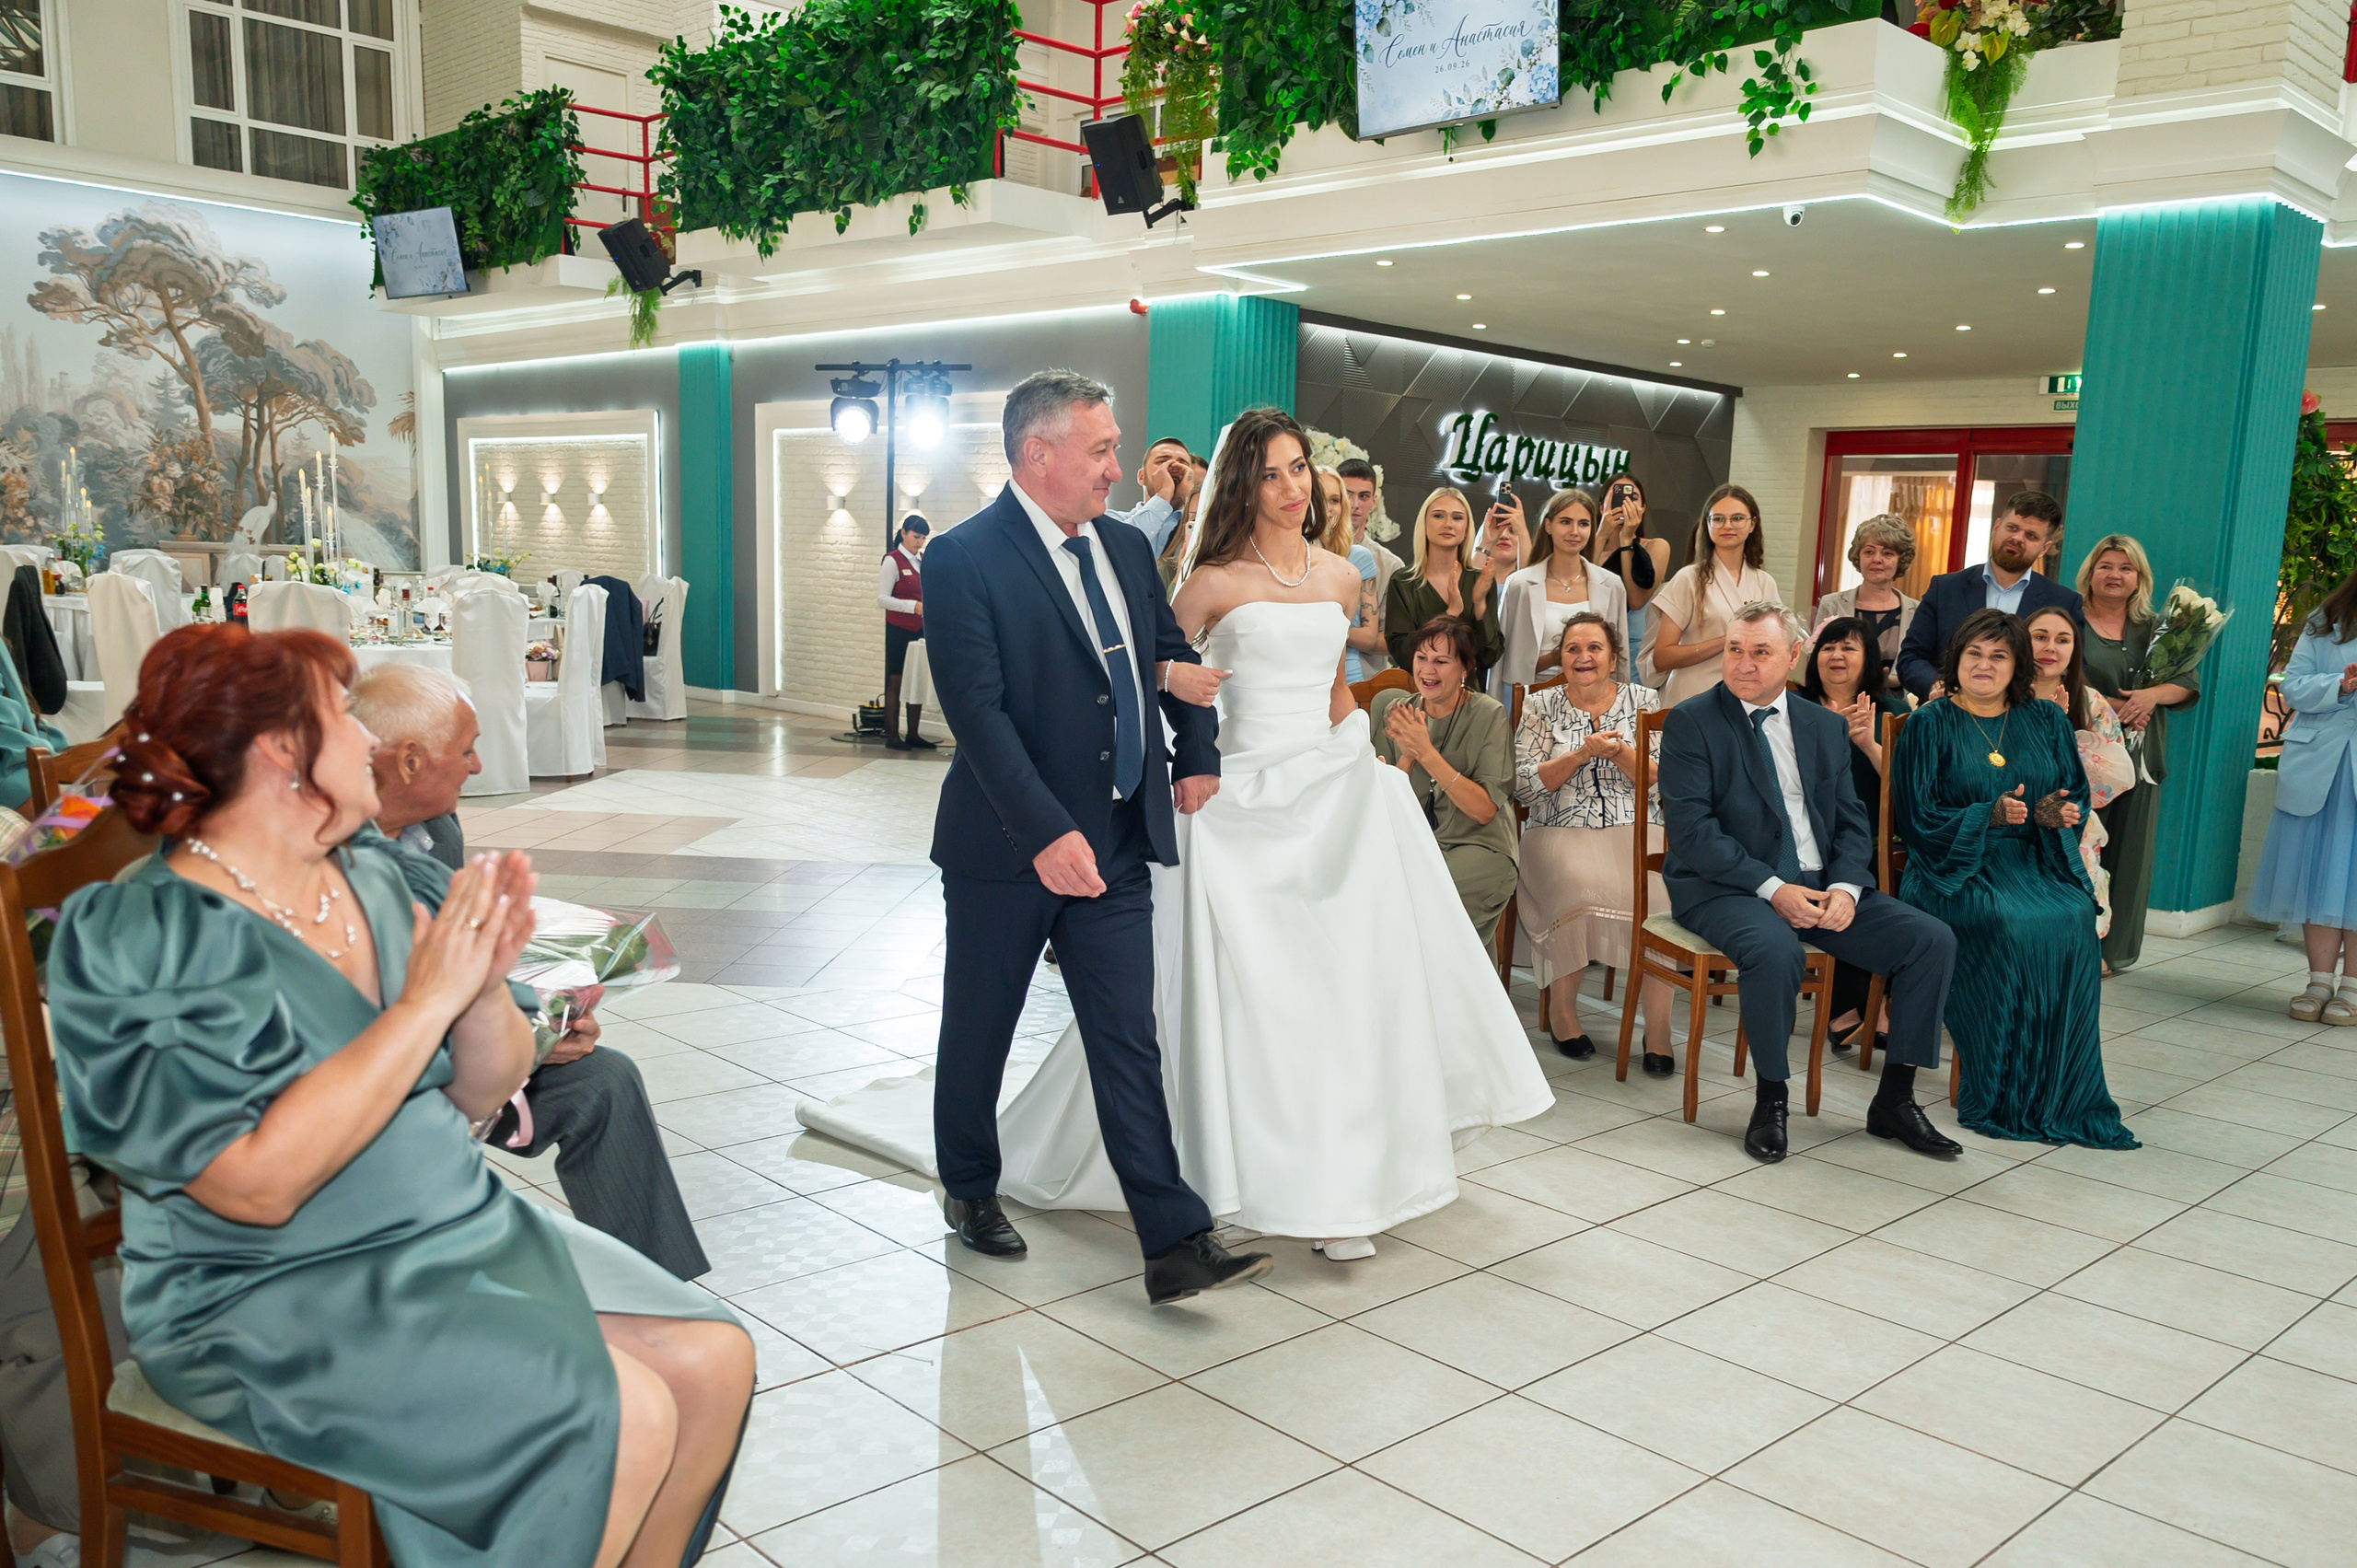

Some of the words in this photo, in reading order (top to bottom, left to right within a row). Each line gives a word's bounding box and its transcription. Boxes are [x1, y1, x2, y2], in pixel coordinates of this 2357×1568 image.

[1378, 33, 1430, 69] Семен
[1429, 41, 1437, 55] и
[1436, 14, 1534, 60] Анастасия
[1434, 60, 1470, 74] 26.09.26
[1448, 411, 1631, 488] Царицын
